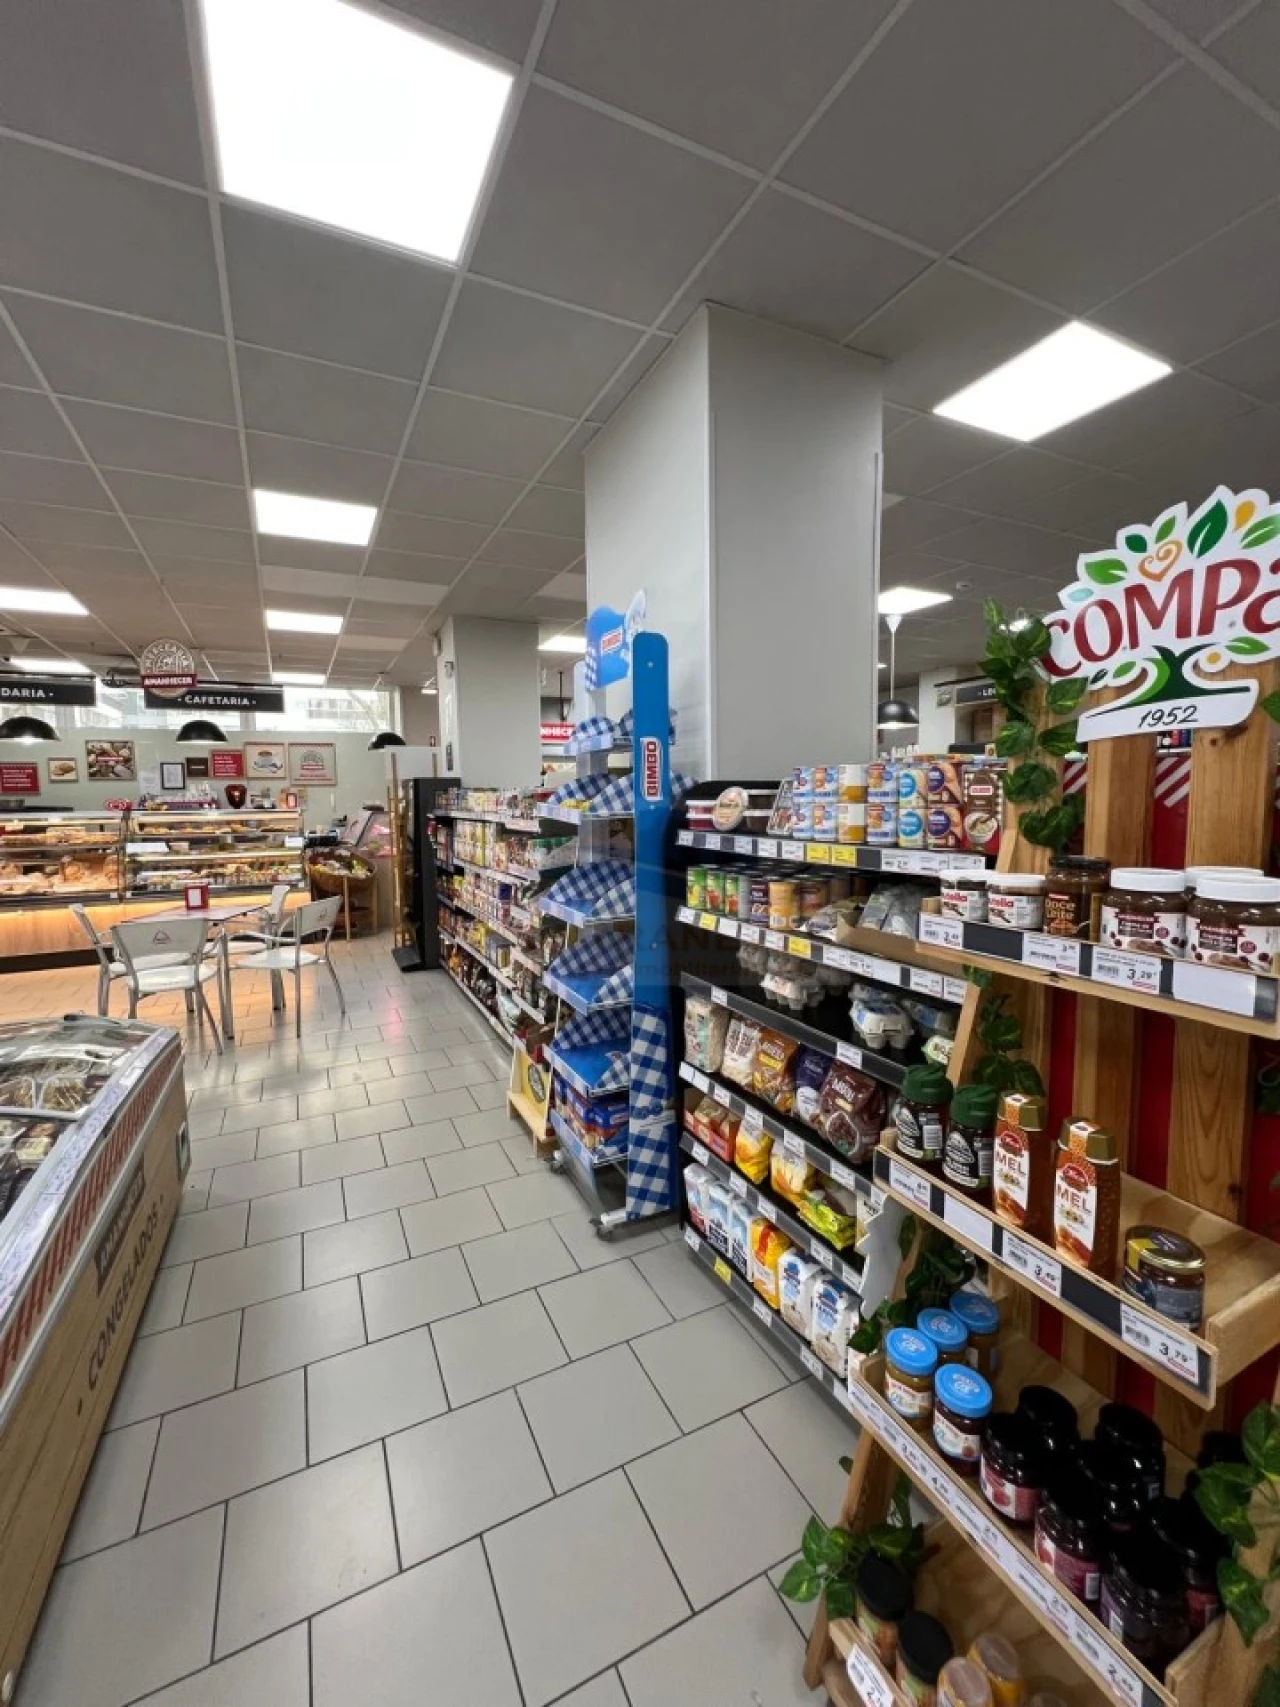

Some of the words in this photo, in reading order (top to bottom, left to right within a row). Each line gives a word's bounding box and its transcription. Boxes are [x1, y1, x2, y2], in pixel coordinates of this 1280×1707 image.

[185, 694, 250, 706] CAFETARIA
[1138, 705, 1198, 729] 1952
[995, 1151, 1027, 1176] MEL
[1056, 1184, 1092, 1214] MEL
[89, 1204, 160, 1391] CONGELADOS
